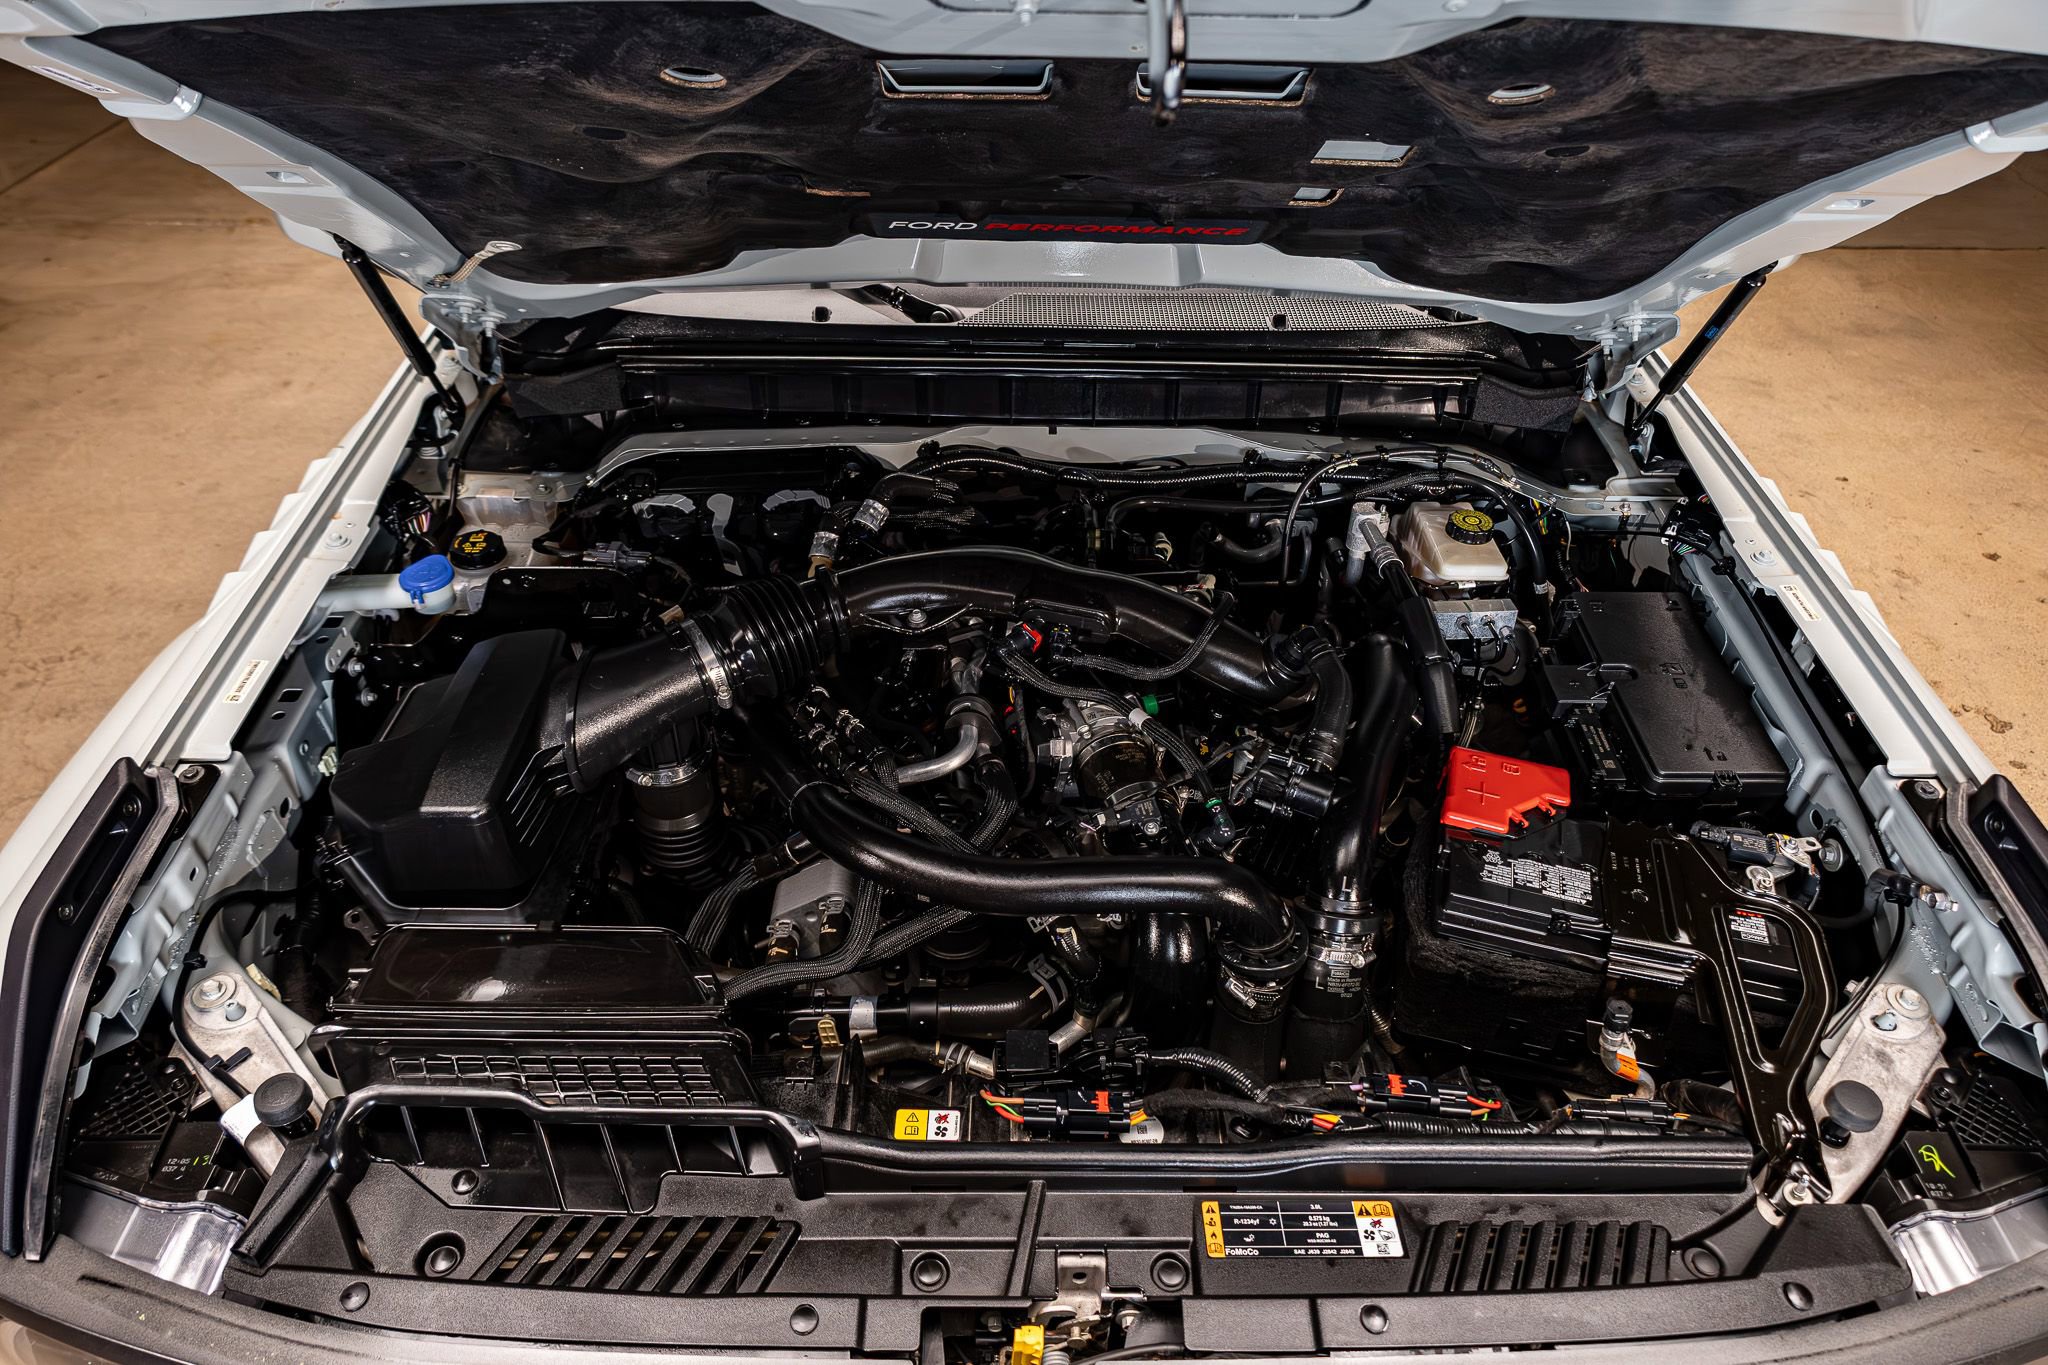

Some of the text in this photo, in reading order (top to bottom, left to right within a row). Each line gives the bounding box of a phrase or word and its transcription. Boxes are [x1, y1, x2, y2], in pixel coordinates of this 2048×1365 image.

[888, 220, 1250, 237] FORD PERFORMANCE
[1315, 976, 1325, 990] L
[1233, 1218, 1260, 1226] R-1234yf
[1225, 1247, 1260, 1256] FoMoCo
